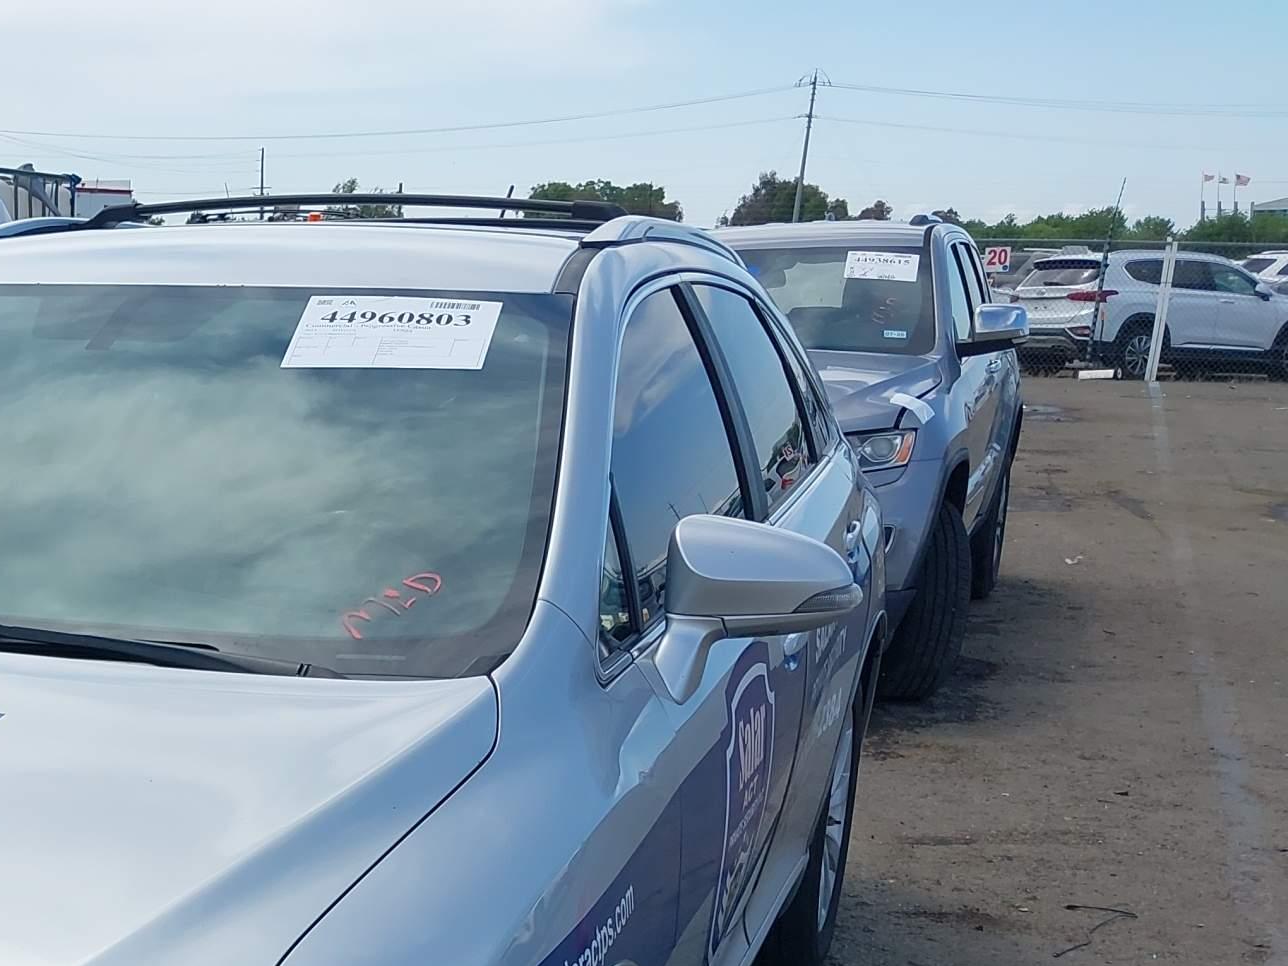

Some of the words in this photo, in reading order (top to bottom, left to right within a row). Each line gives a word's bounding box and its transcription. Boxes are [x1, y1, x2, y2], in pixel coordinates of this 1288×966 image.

[986, 248, 1008, 266] 20
[320, 310, 472, 327] 44960803
[738, 703, 766, 792] Salar
